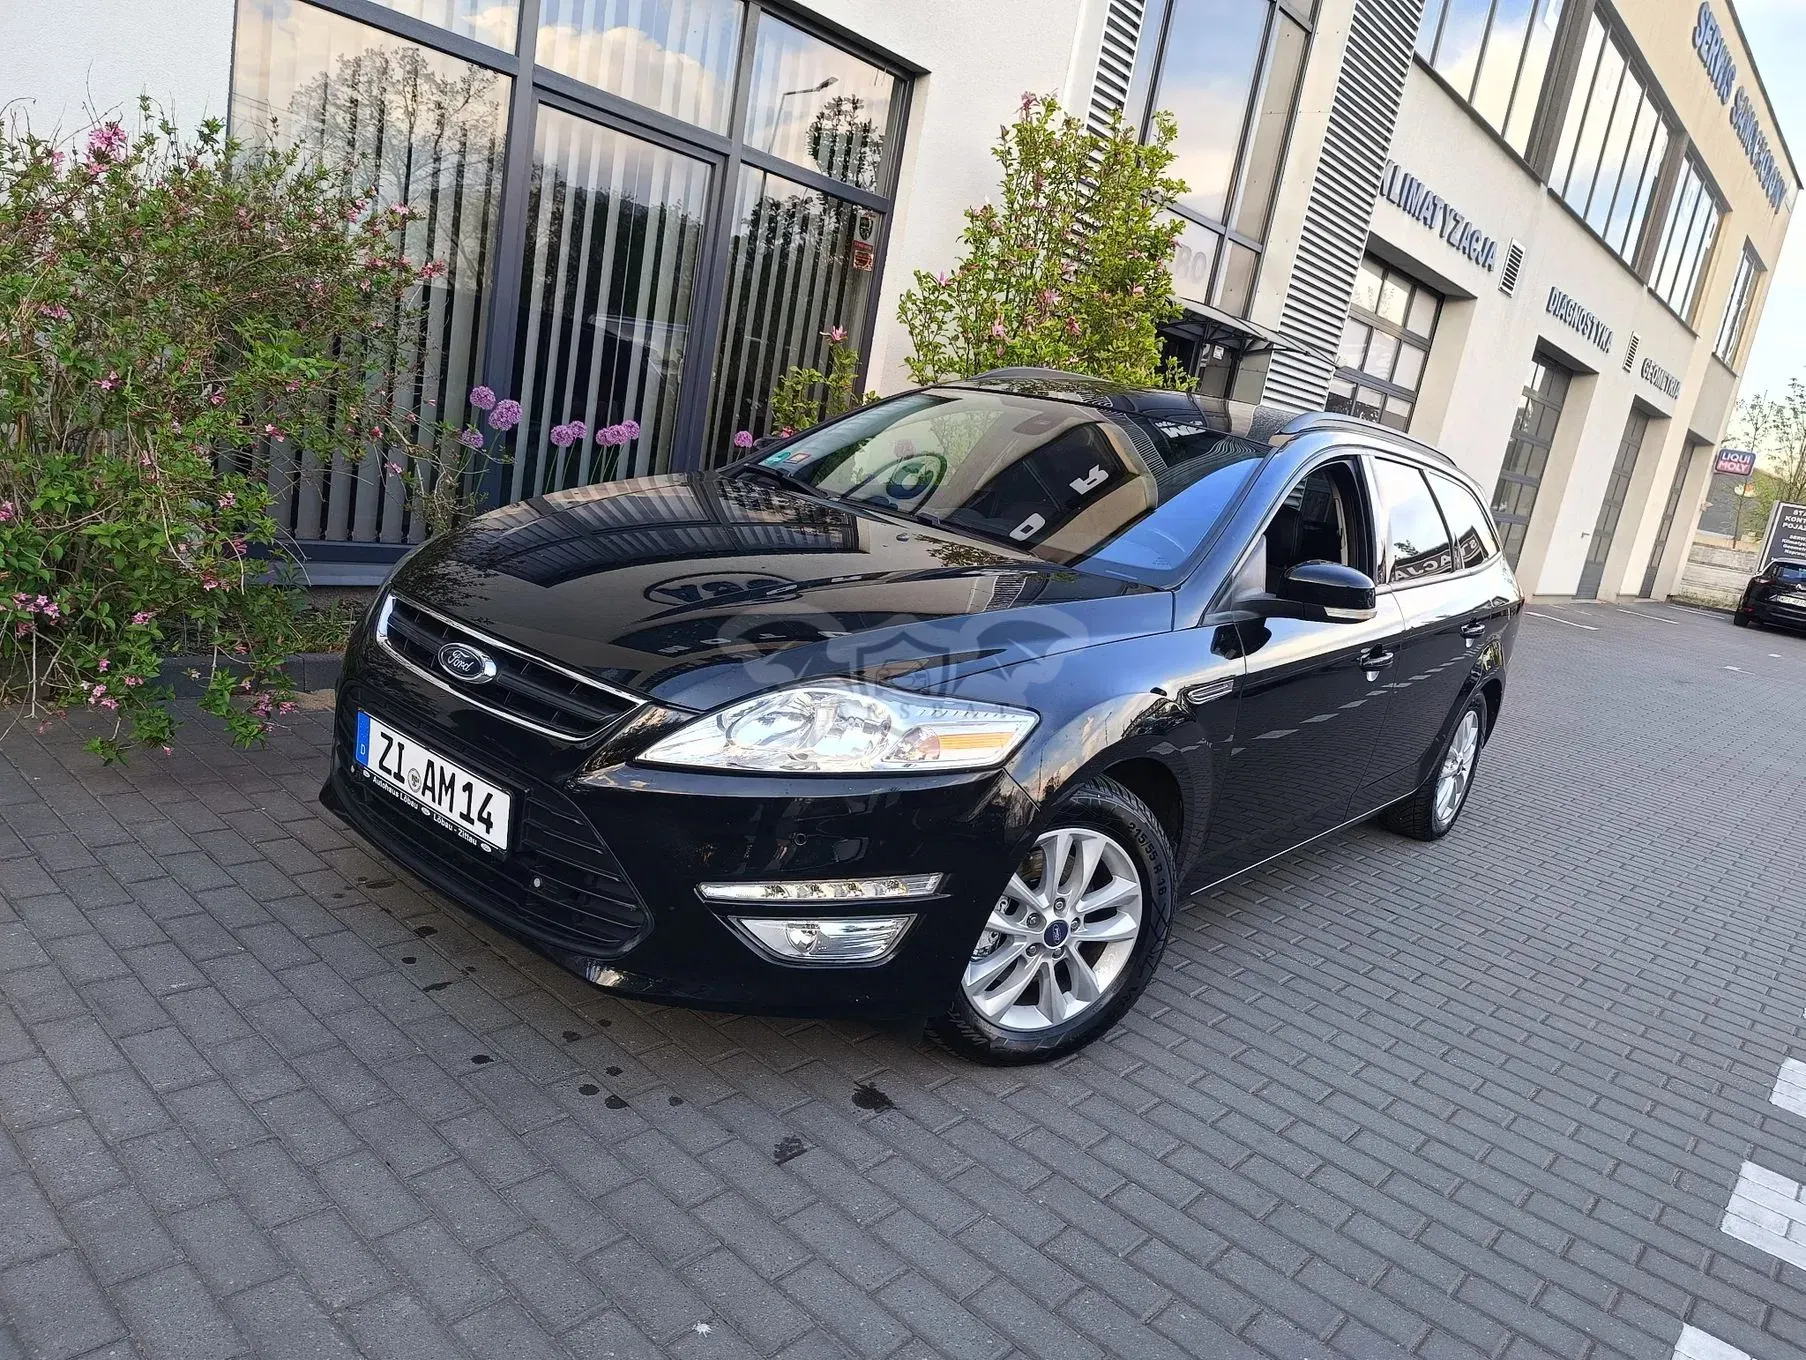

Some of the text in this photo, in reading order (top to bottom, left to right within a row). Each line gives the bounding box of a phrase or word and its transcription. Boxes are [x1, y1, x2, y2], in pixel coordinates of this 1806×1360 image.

[1692, 1, 1736, 105] SERWIS
[1546, 286, 1614, 353] DIAGNOSTYKA
[1718, 461, 1749, 473] MOLY
[1722, 452, 1751, 464] LIQUI
[448, 650, 475, 672] Ford
[378, 731, 406, 784] ZI
[373, 776, 399, 798] Autohaus
